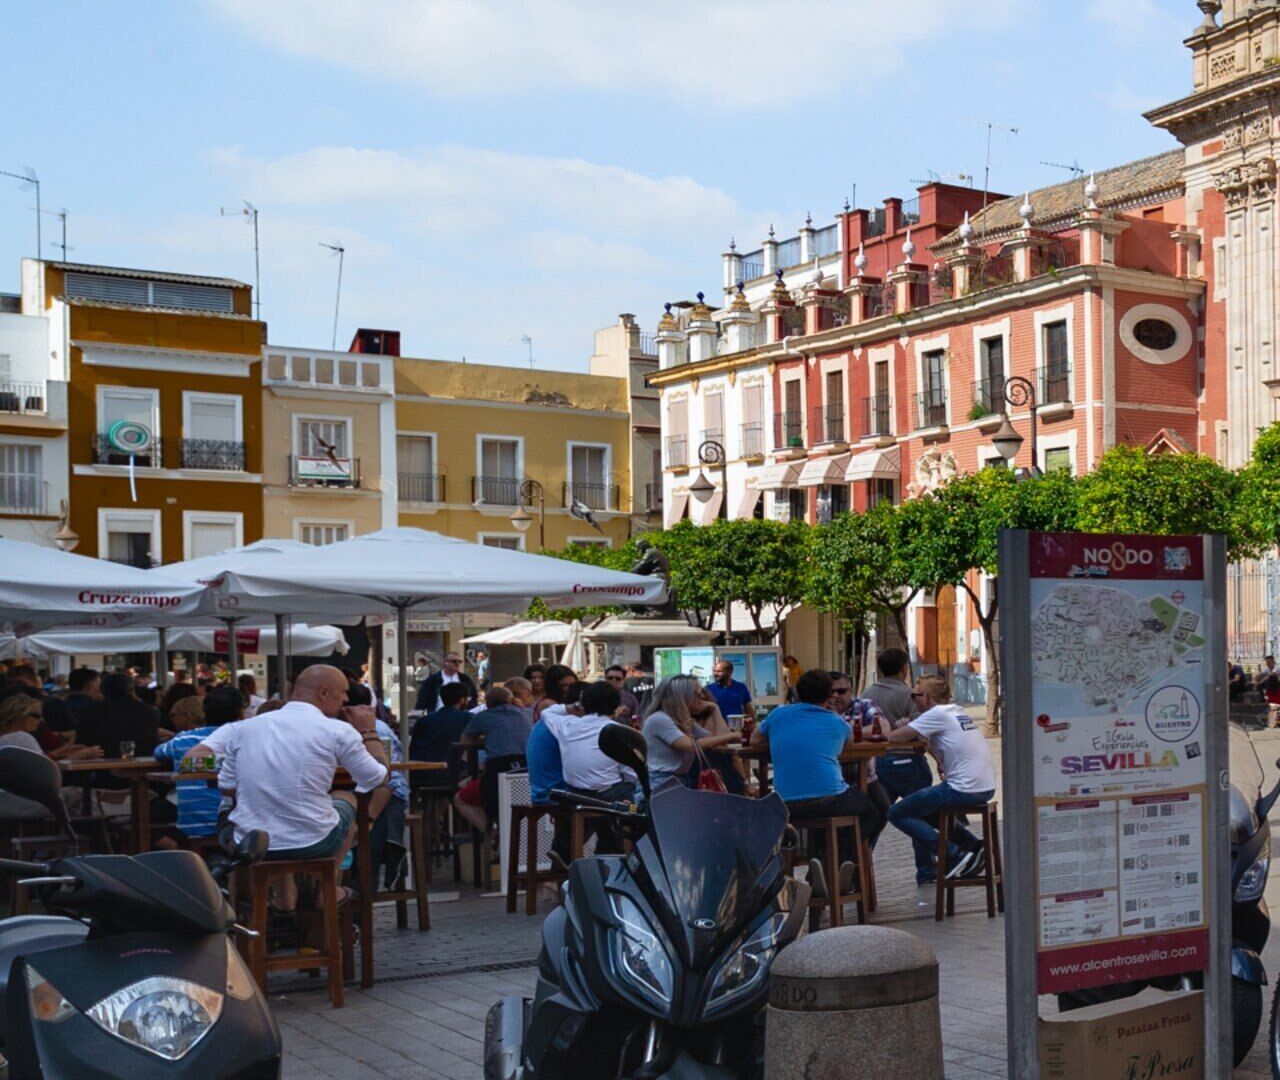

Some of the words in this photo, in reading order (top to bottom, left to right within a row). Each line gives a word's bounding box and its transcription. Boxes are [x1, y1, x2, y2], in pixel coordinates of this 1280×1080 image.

[78, 590, 181, 608] Cruzcampo
[1061, 749, 1179, 775] SEVILLA
[1050, 945, 1197, 976] www.alcentrosevilla.com
[1117, 1022, 1159, 1039] Patatas
[1161, 1013, 1192, 1028] Fritas
